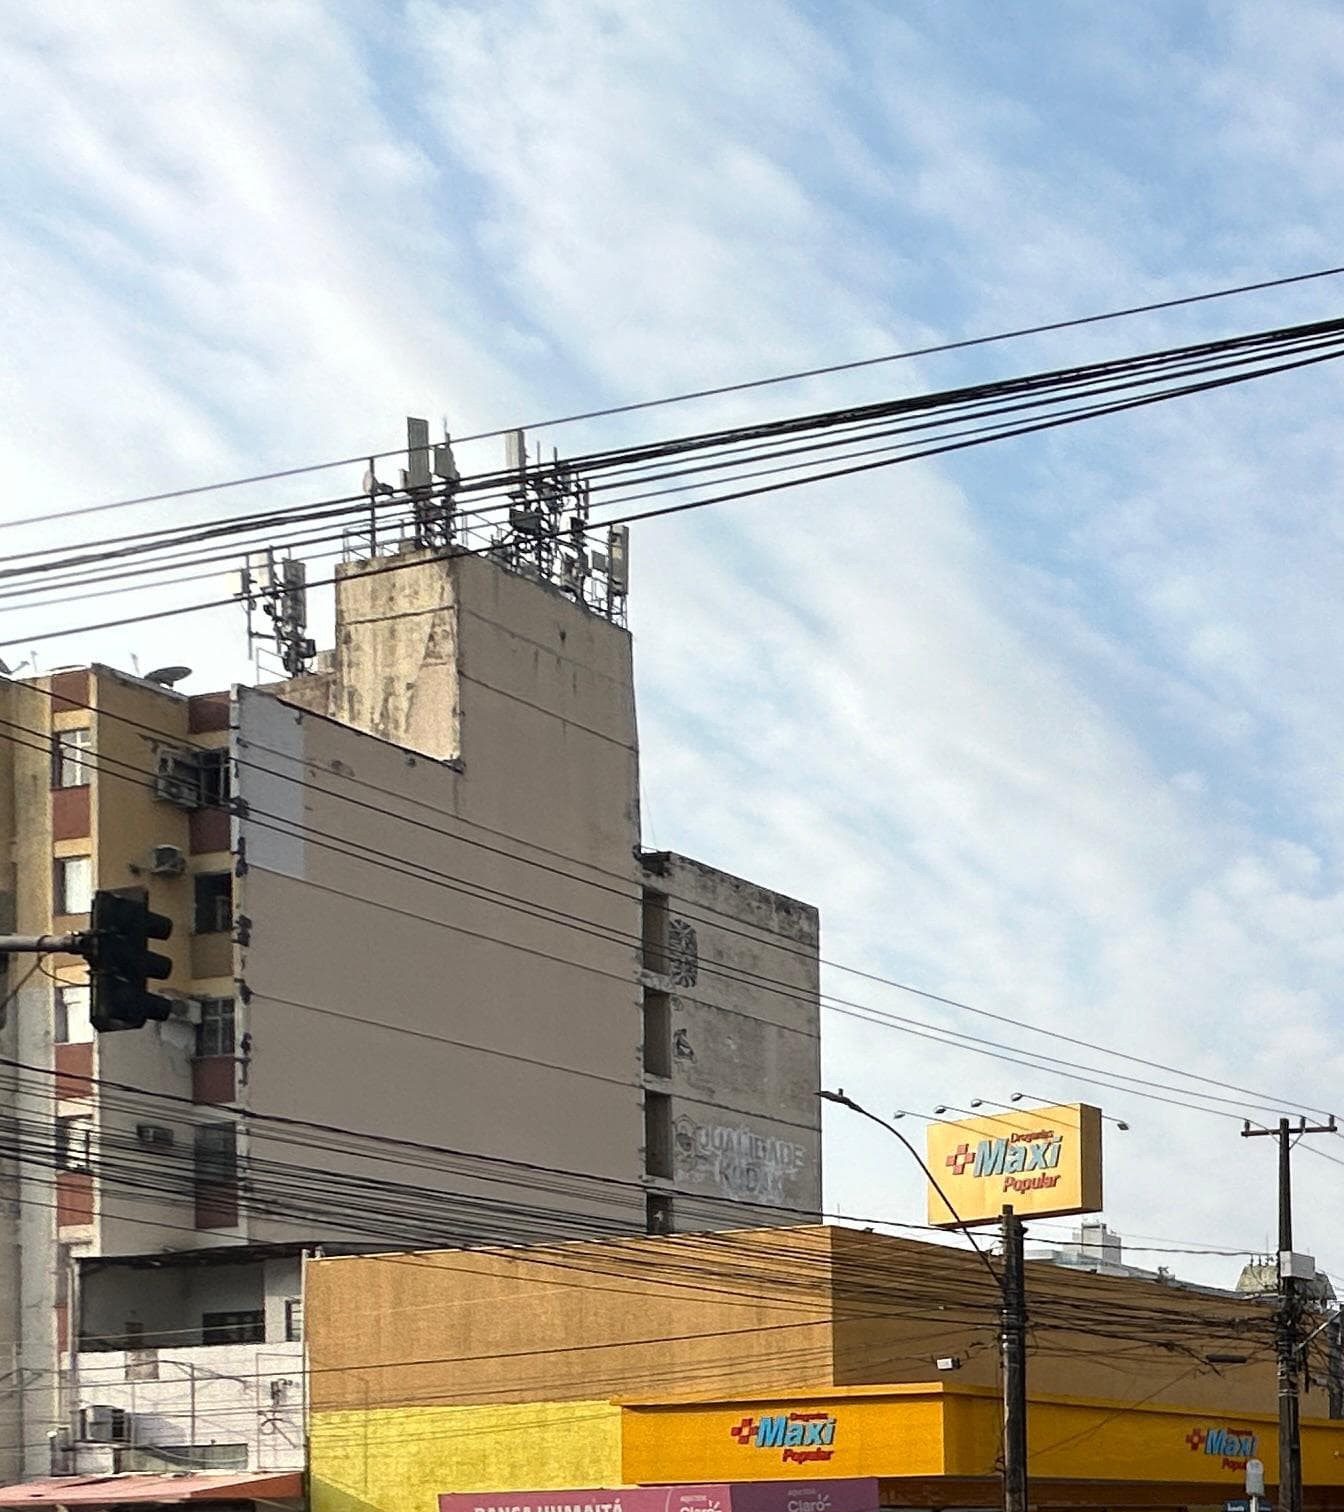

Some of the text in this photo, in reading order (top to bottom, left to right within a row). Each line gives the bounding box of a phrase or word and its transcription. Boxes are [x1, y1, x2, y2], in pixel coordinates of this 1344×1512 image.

[974, 1135, 1063, 1178] Maxi
[1003, 1172, 1061, 1194] Popular
[756, 1416, 837, 1448] Maxi
[1204, 1427, 1257, 1456] Maxi
[782, 1447, 834, 1464] Popular
[788, 1497, 828, 1512] Claro
